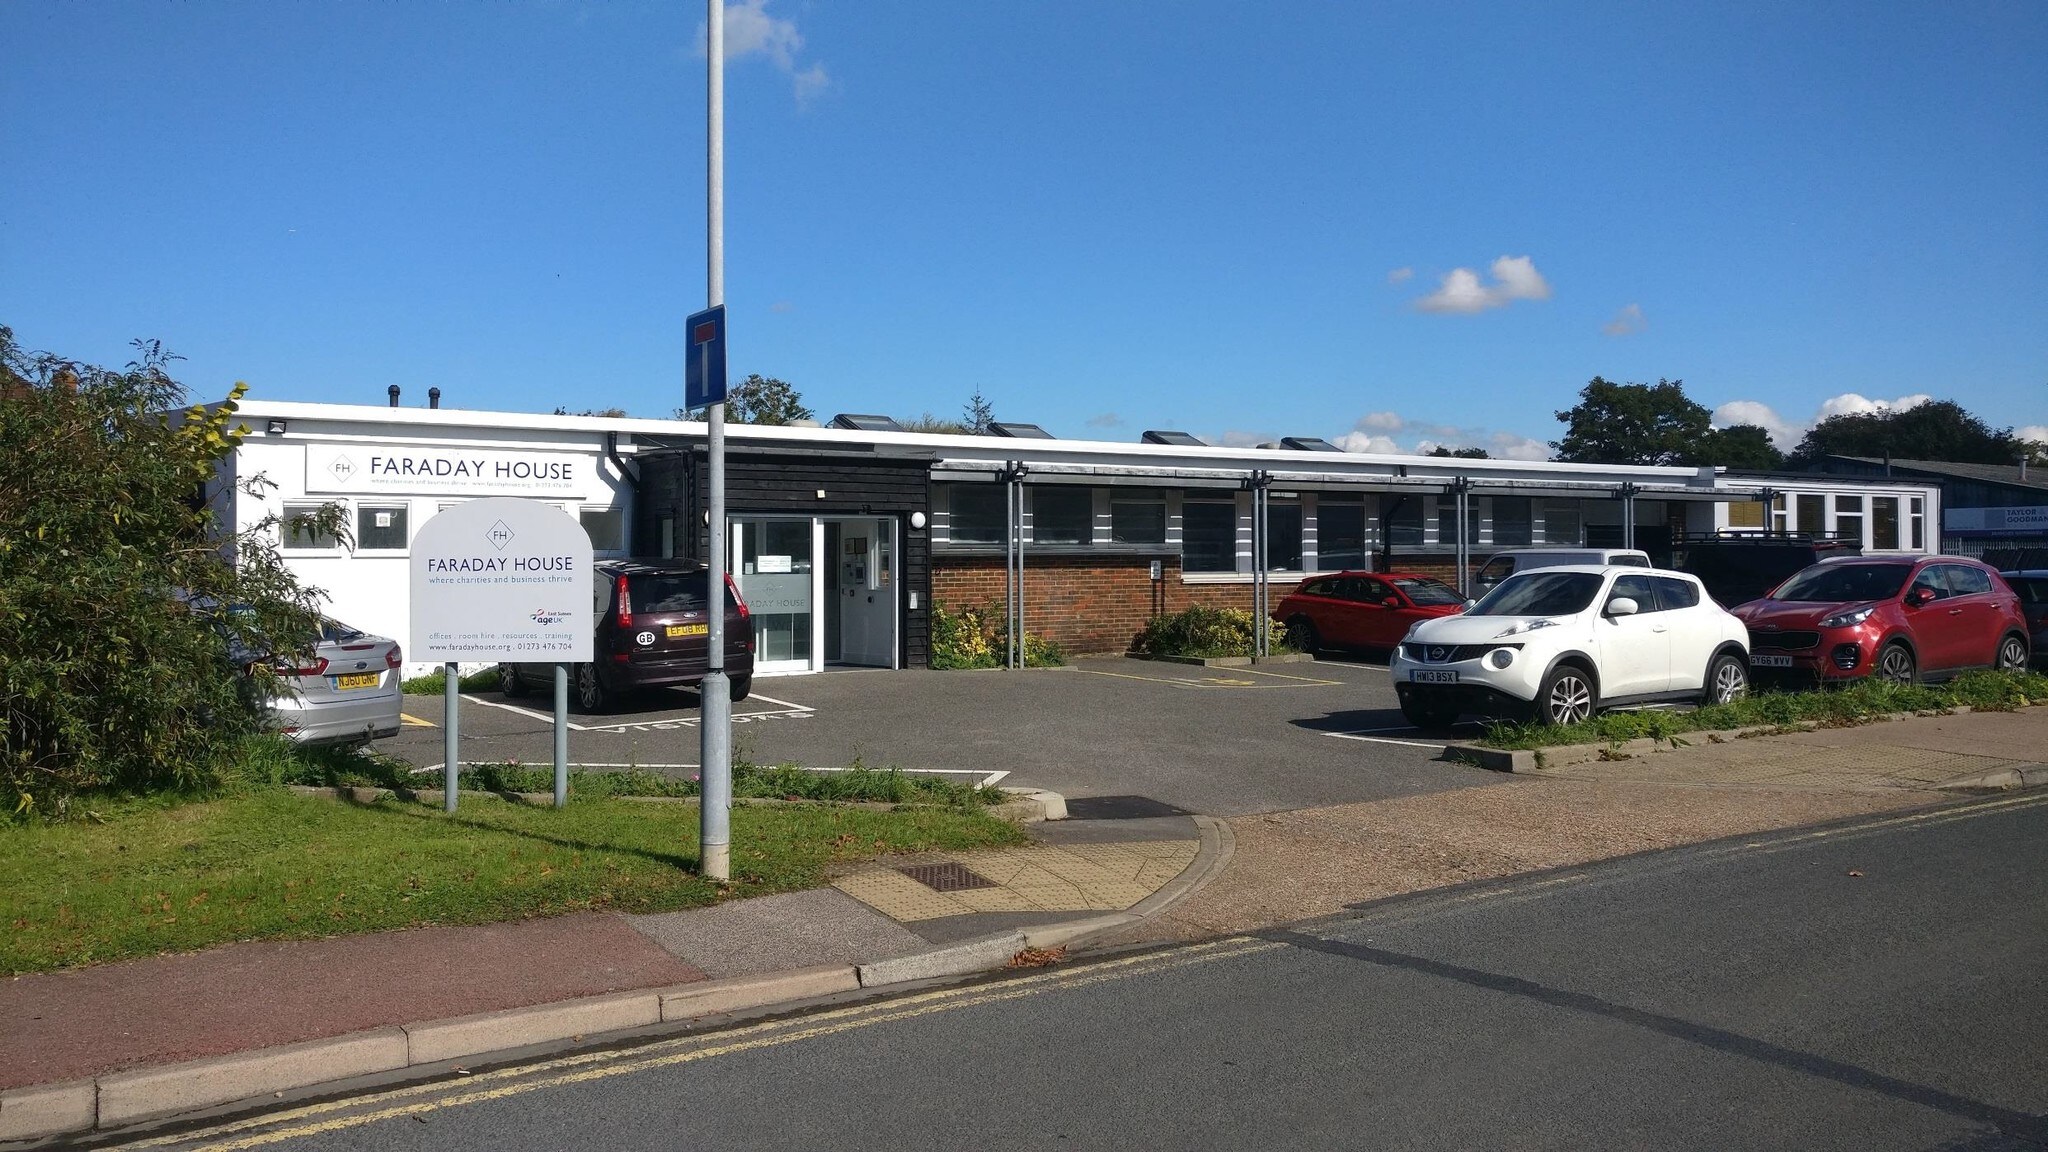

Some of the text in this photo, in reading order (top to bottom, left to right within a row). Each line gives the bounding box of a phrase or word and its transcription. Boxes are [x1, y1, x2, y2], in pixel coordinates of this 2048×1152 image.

[335, 463, 351, 473] FH
[371, 456, 572, 480] FARADAY HOUSE
[493, 530, 508, 540] FH
[428, 556, 573, 572] FARADAY HOUSE
[429, 574, 573, 584] where charities and business thrive
[776, 599, 805, 608] HOUSE
[429, 632, 452, 640] offices
[480, 631, 495, 640] hire
[544, 632, 573, 641] training
[639, 632, 653, 643] GB
[428, 642, 572, 652] www.faradayhouse.org 01273 476 704
[1416, 671, 1453, 682] HW13 BSX
